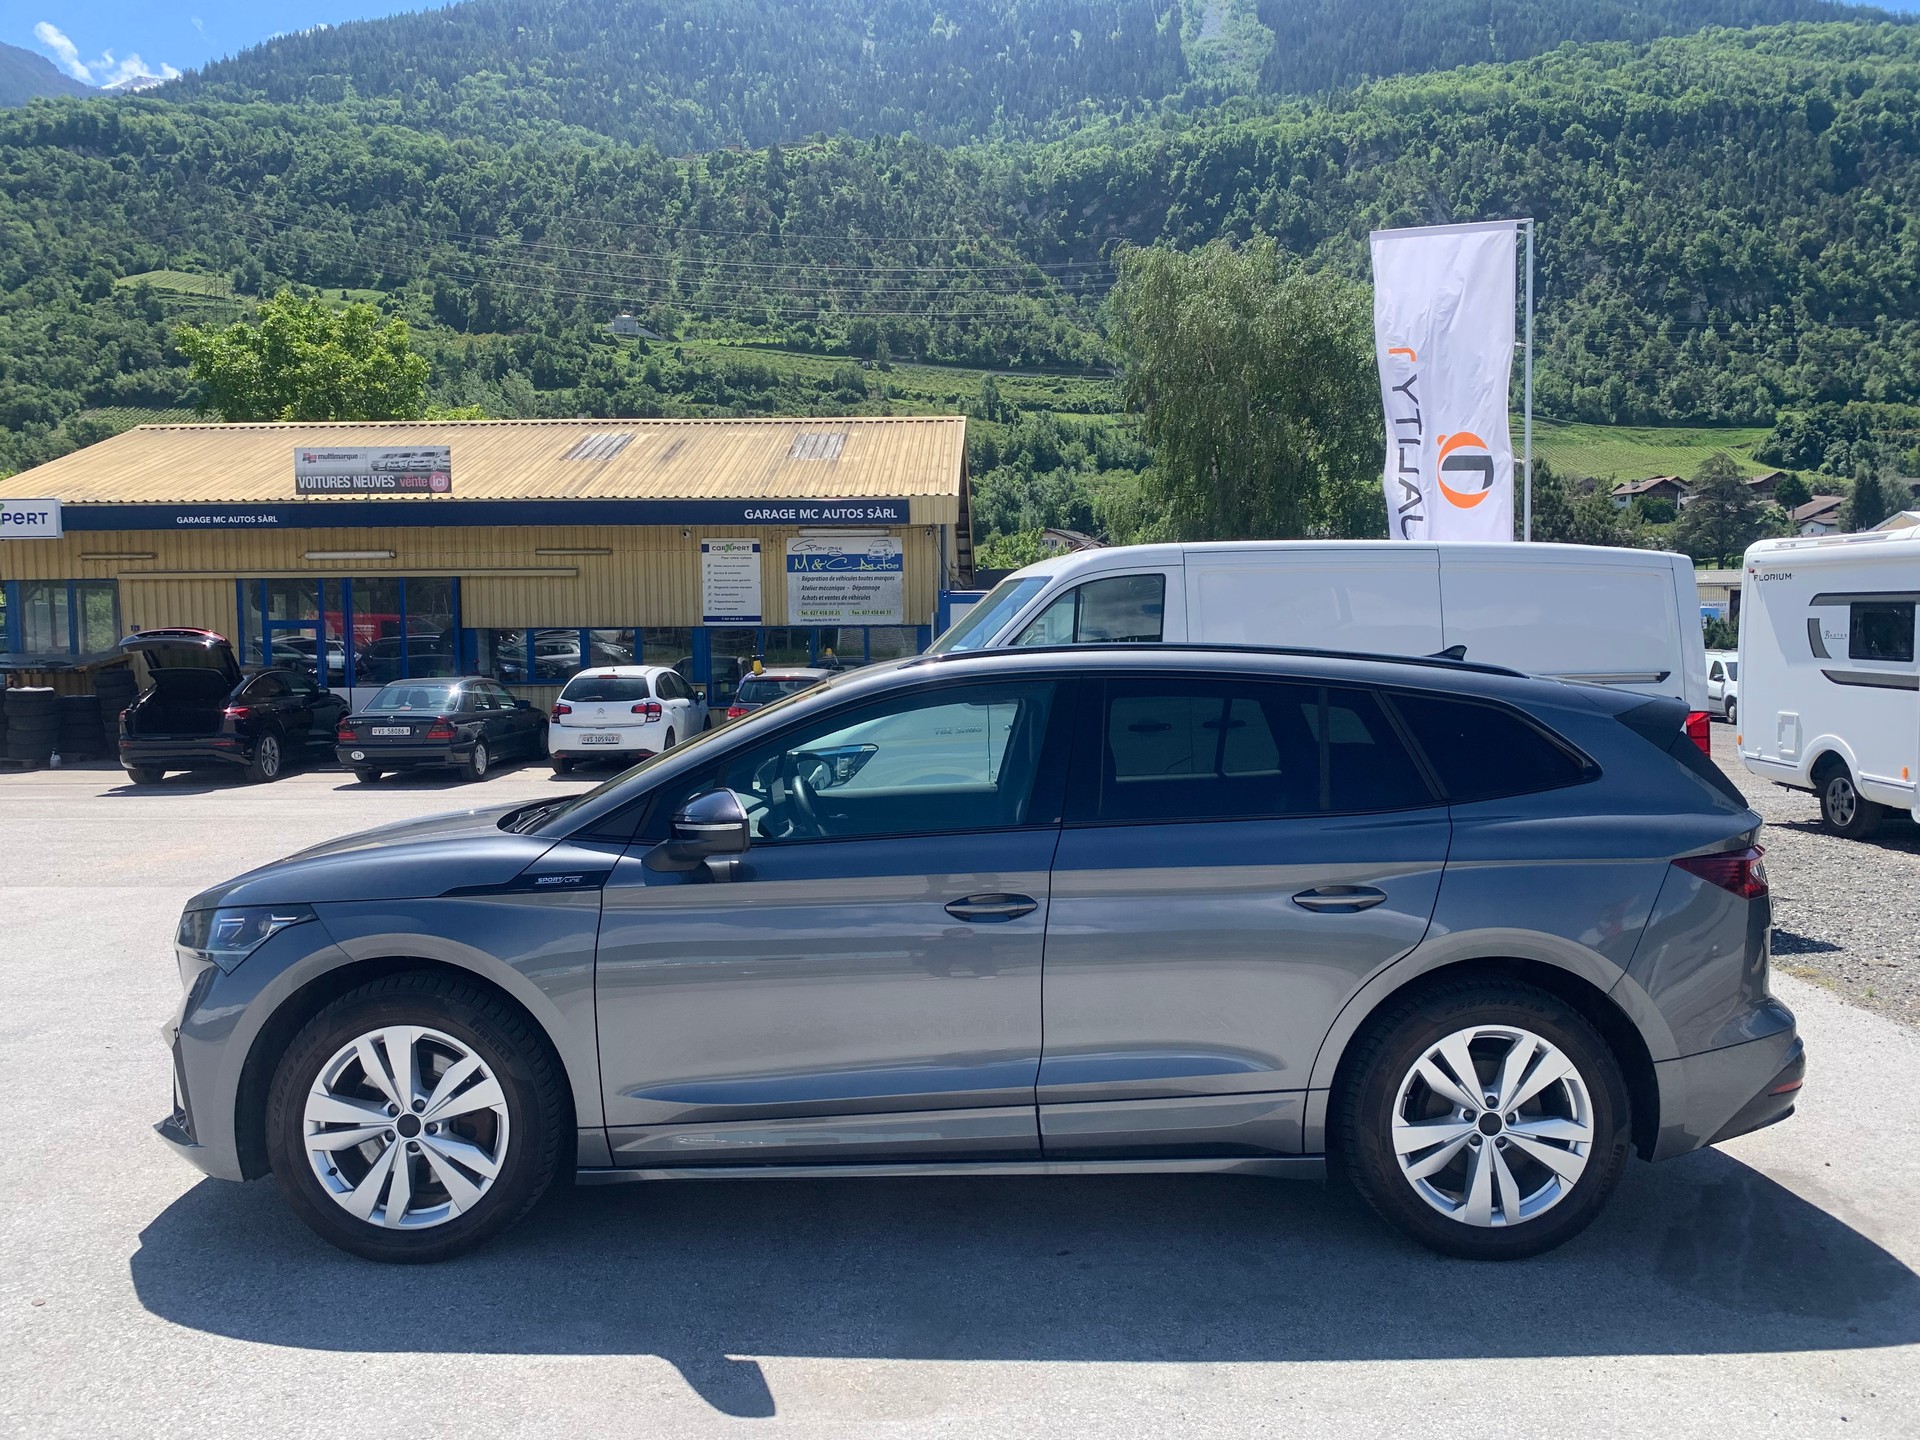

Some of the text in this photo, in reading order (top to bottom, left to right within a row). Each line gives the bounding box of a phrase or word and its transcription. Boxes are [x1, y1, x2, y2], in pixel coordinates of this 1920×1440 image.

[298, 475, 350, 489] VOITURES
[352, 475, 395, 488] NEUVES
[432, 476, 445, 487] ici
[744, 506, 898, 519] GARAGE MC AUTOS SÀRL
[176, 516, 211, 524] GARAGE
[213, 515, 227, 523] MC
[228, 515, 256, 523] AUTOS
[792, 539, 842, 556] Garage
[852, 557, 899, 571] Autos
[1753, 573, 1792, 582] FLORIUM
